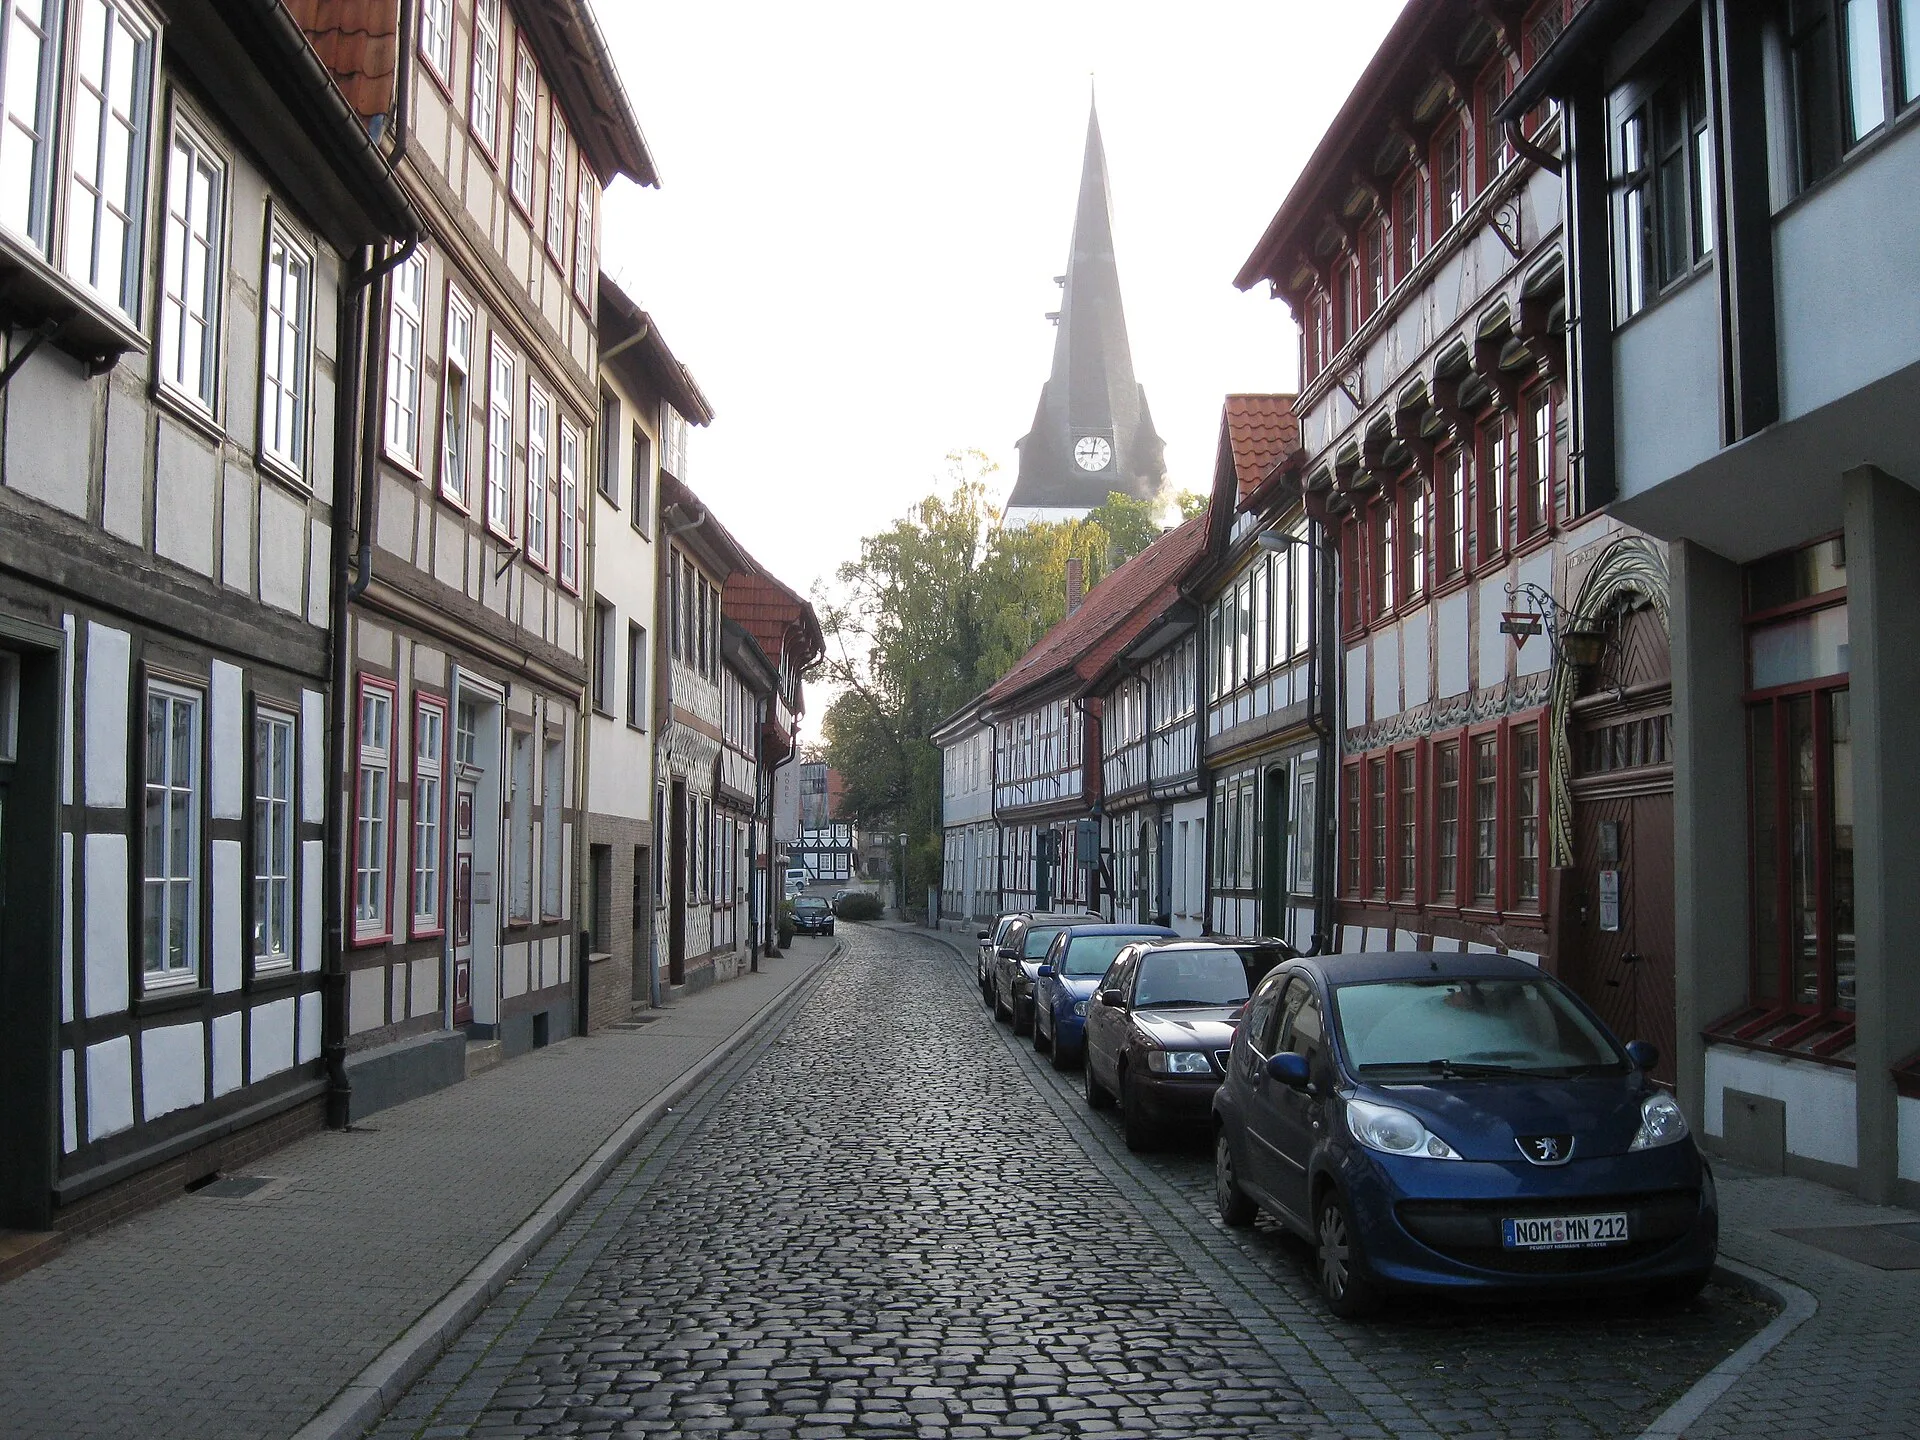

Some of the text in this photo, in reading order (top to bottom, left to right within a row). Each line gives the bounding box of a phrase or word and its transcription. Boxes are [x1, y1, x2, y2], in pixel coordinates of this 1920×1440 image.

[1516, 1217, 1626, 1242] NOM MN 212
